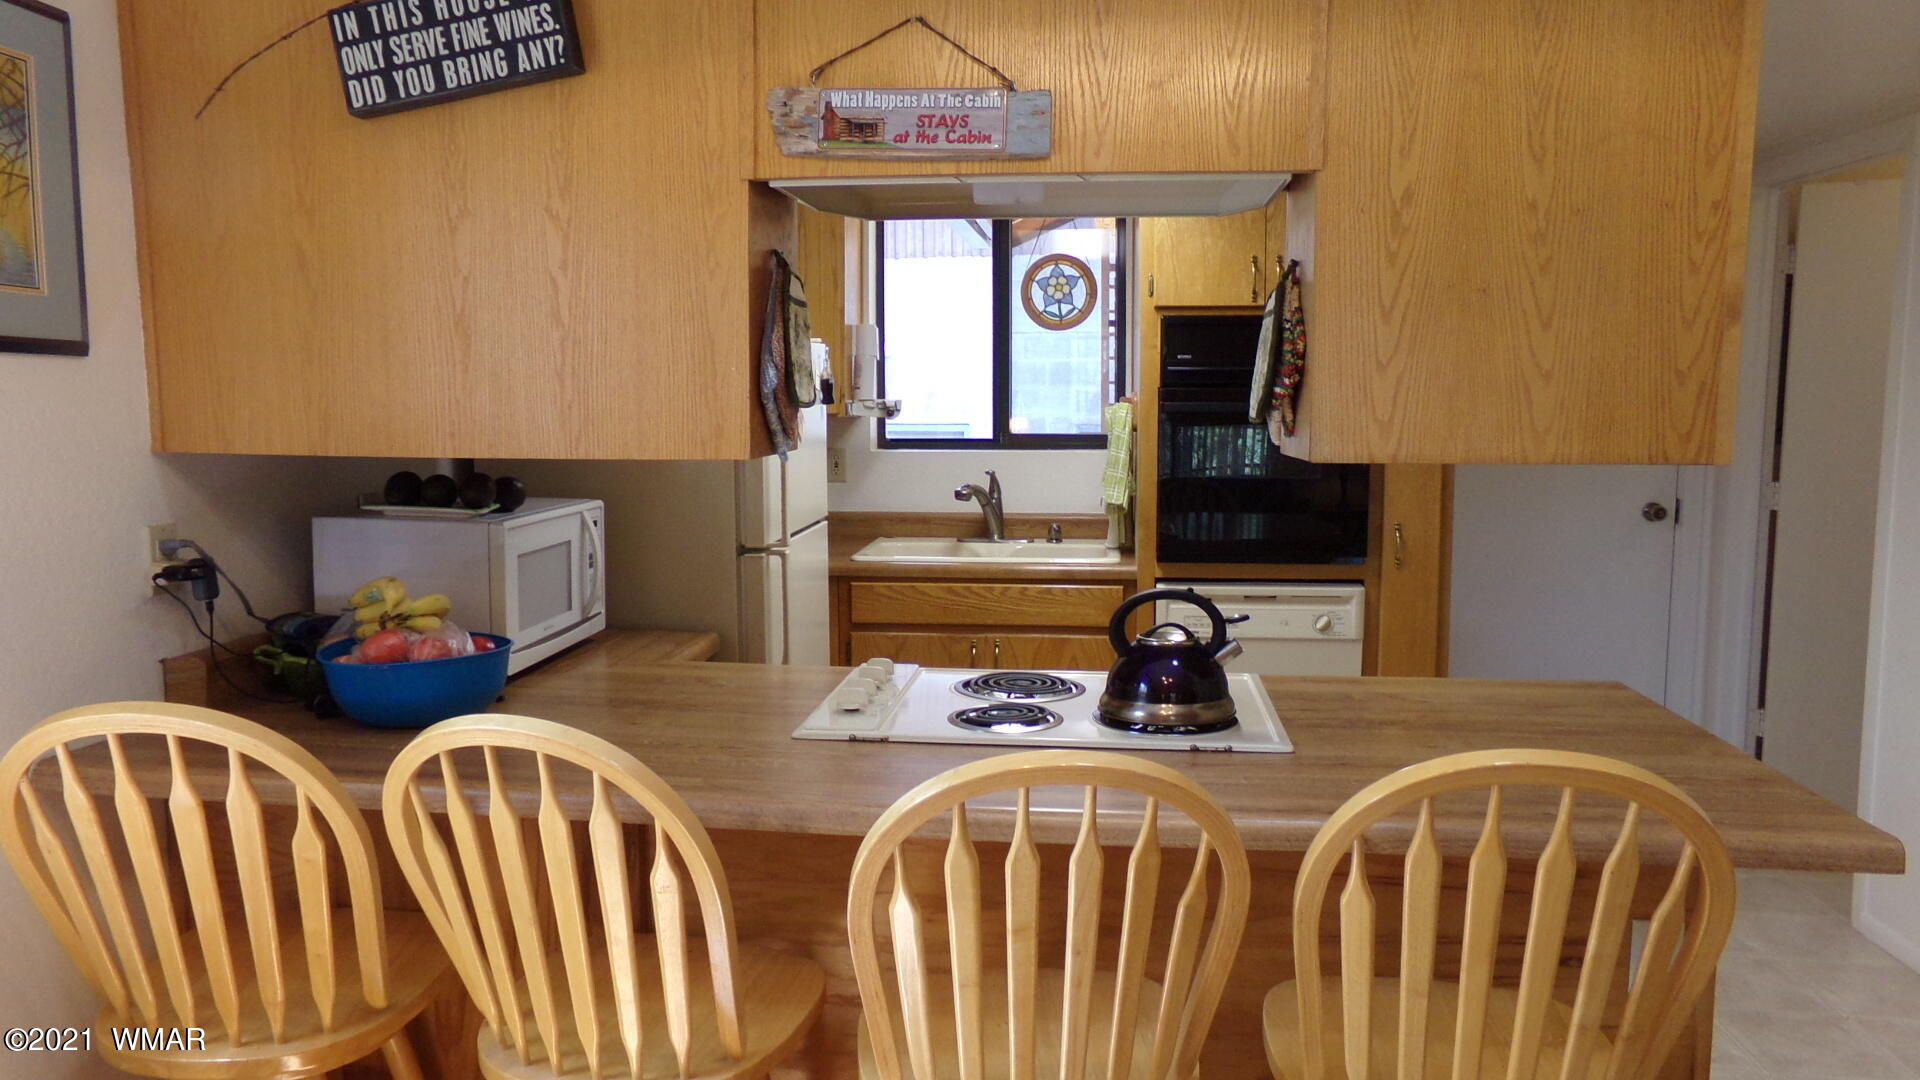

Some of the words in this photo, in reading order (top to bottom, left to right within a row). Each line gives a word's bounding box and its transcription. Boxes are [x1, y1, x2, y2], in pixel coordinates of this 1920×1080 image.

[333, 11, 360, 42] IN
[367, 0, 423, 34] THIS
[341, 39, 386, 76] ONLY
[389, 26, 449, 65] SERVE
[450, 17, 492, 52] FINE
[493, 3, 560, 42] WINES.
[347, 74, 387, 109] DID
[392, 64, 436, 99] YOU
[442, 48, 509, 89] BRING
[517, 35, 565, 73] ANY?
[830, 90, 863, 108] What
[865, 90, 918, 110] Happens
[920, 92, 935, 108] At
[937, 92, 962, 108] The
[964, 92, 1001, 108] Cabin
[893, 129, 911, 144] at
[915, 129, 939, 144] the
[944, 129, 992, 144] Cabin
[916, 113, 970, 129] STAYS
